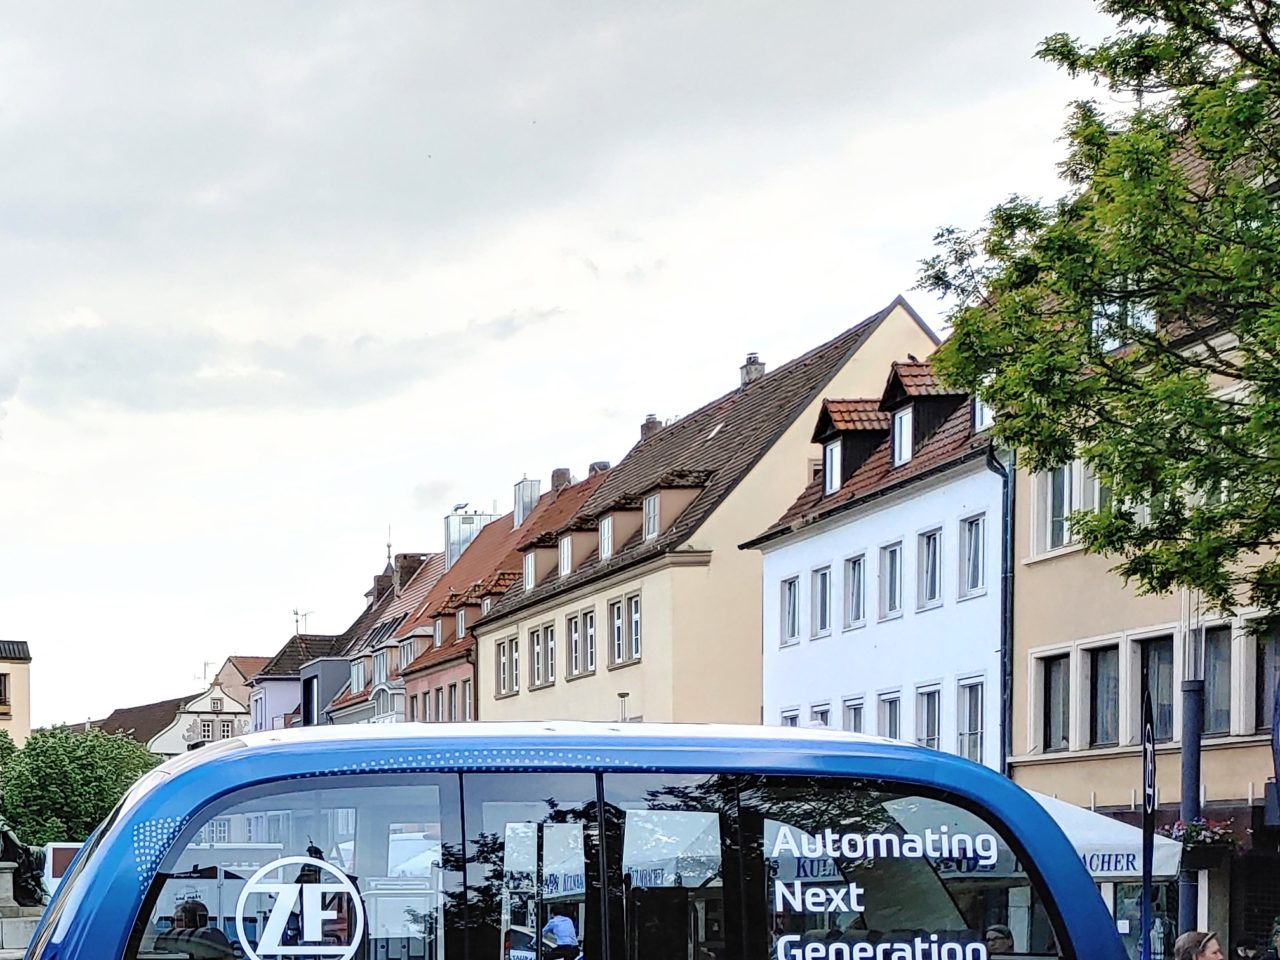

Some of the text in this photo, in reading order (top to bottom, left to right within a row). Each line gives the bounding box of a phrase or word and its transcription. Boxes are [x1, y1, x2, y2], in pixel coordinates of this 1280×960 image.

[770, 825, 998, 866] Automating
[774, 880, 865, 912] Next
[247, 883, 354, 955] ZF
